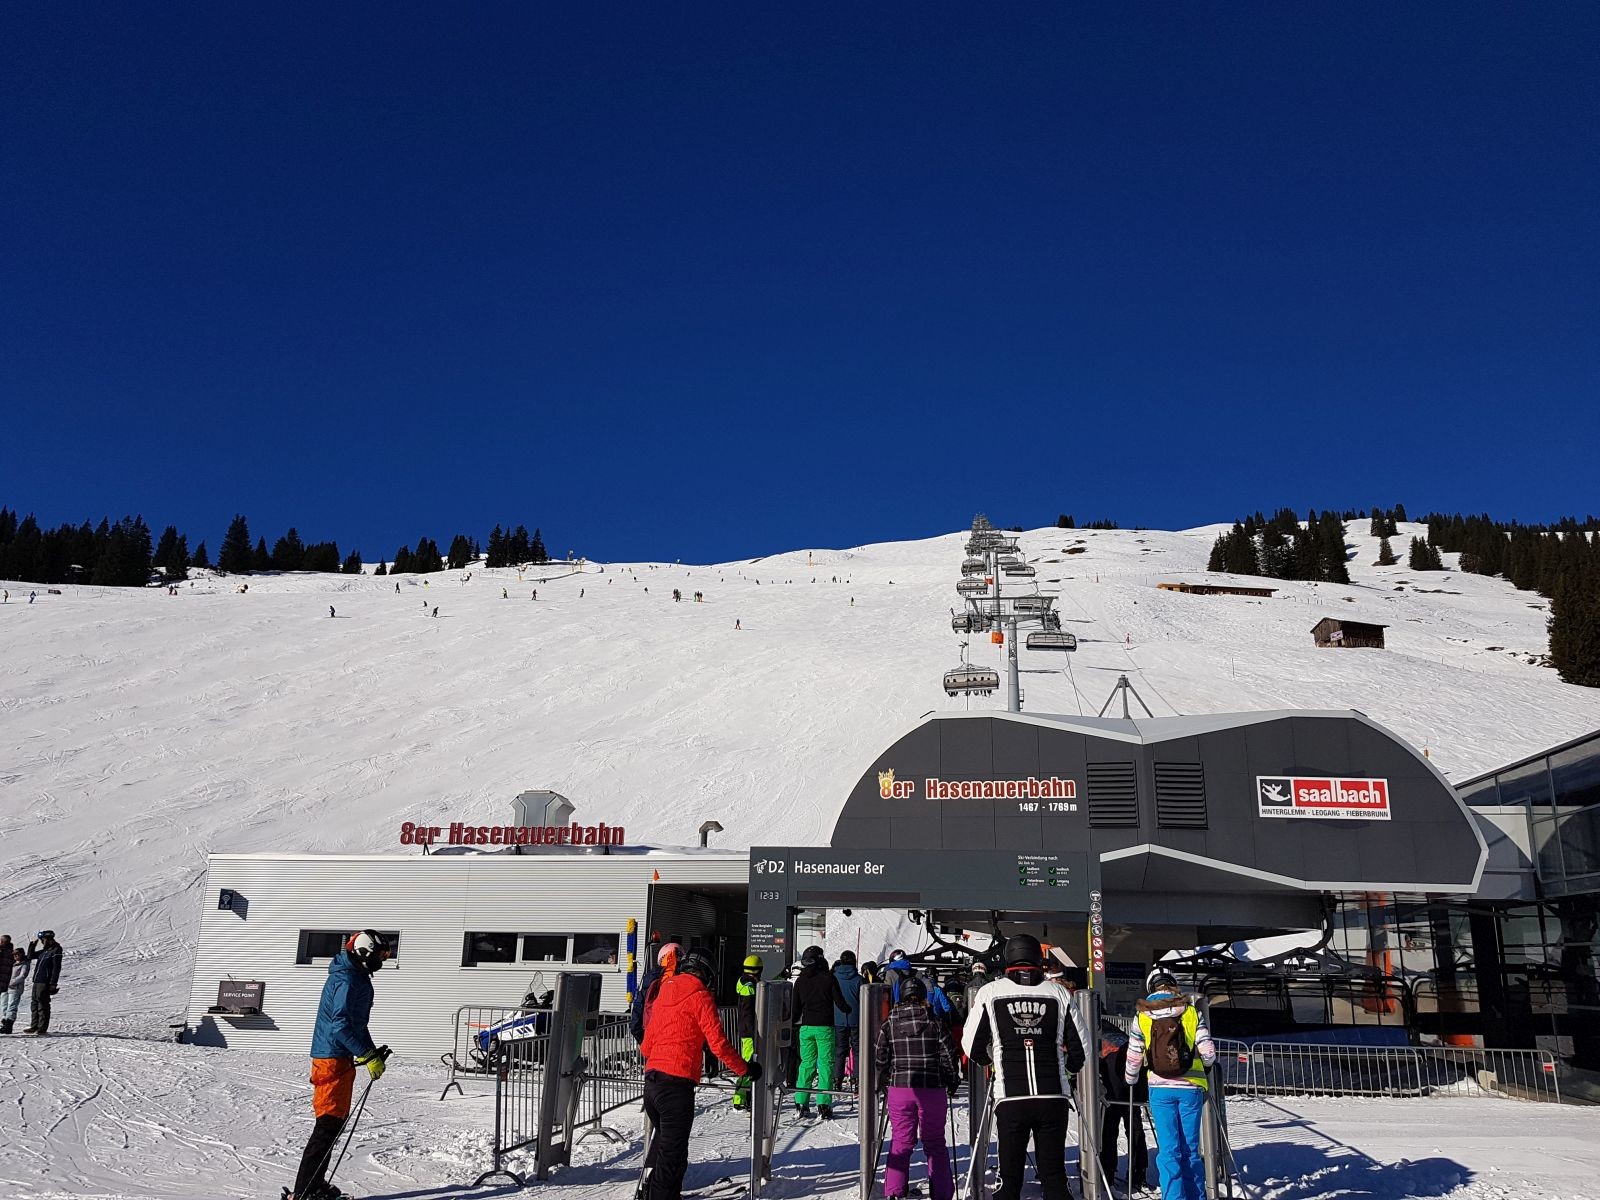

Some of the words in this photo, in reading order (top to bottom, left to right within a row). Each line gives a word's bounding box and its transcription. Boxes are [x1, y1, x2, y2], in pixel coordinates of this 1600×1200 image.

[880, 777, 914, 799] 8er
[926, 777, 1076, 799] Hasenauerbahn
[1298, 780, 1381, 804] saalbach
[1018, 803, 1038, 812] 1467
[400, 822, 441, 845] 8er
[449, 822, 625, 845] Hasenauerbahn
[768, 861, 784, 873] D2
[794, 861, 861, 874] Hasenauer
[864, 861, 885, 874] 8er
[760, 892, 779, 900] 12:33
